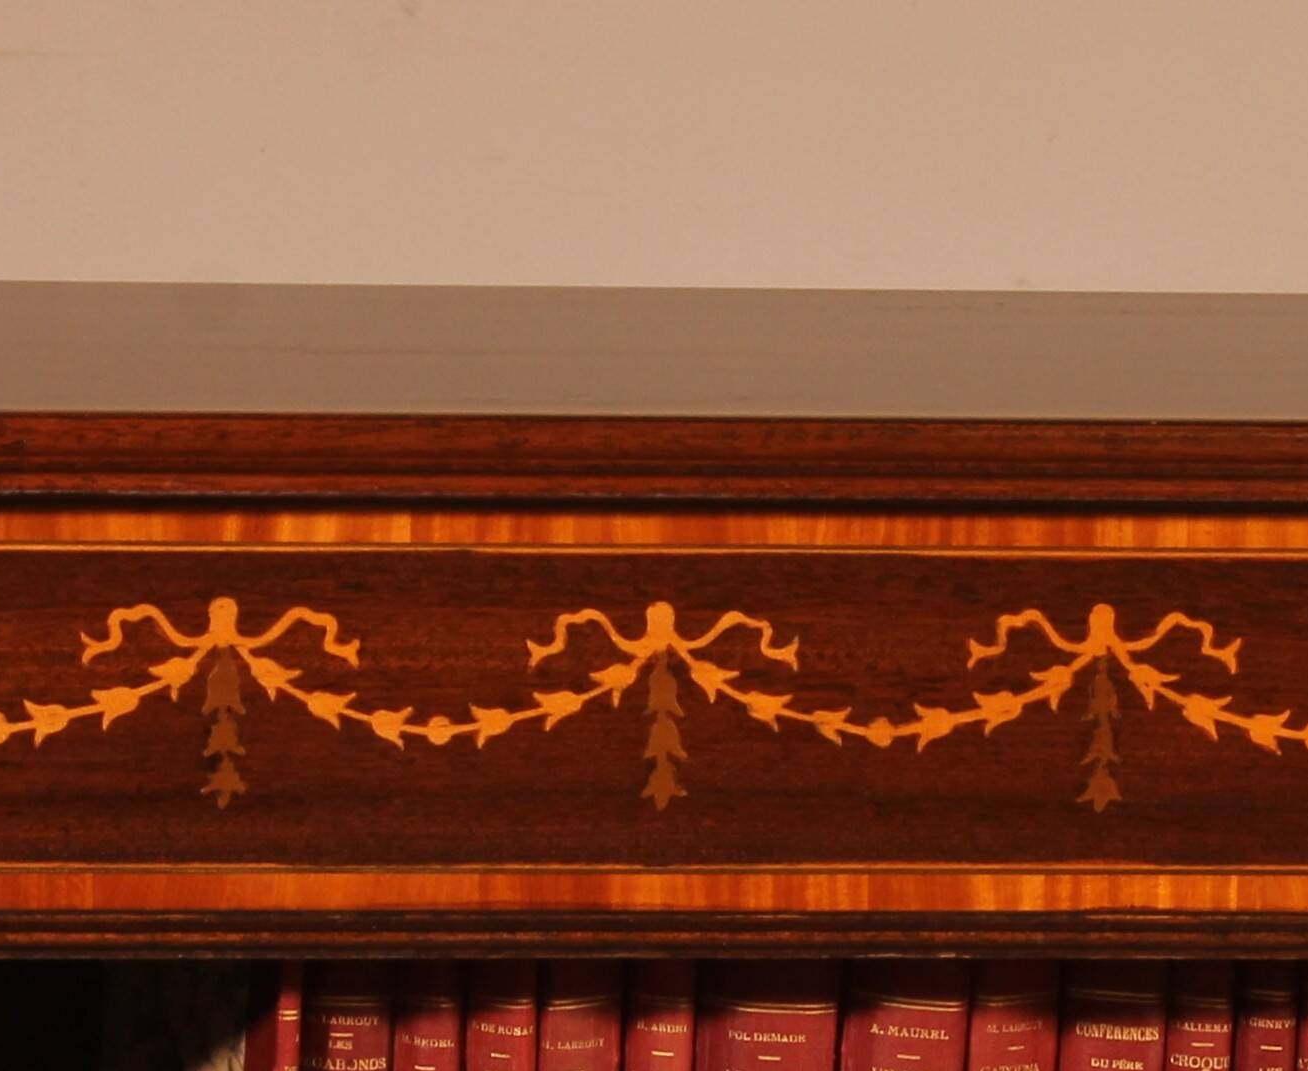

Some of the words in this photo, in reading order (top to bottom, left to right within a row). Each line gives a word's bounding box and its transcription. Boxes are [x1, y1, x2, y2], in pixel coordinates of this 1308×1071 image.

[870, 1023, 884, 1035] A.
[888, 1026, 949, 1040] MAUREL
[328, 1040, 353, 1050] LES
[1091, 1058, 1109, 1068] DU
